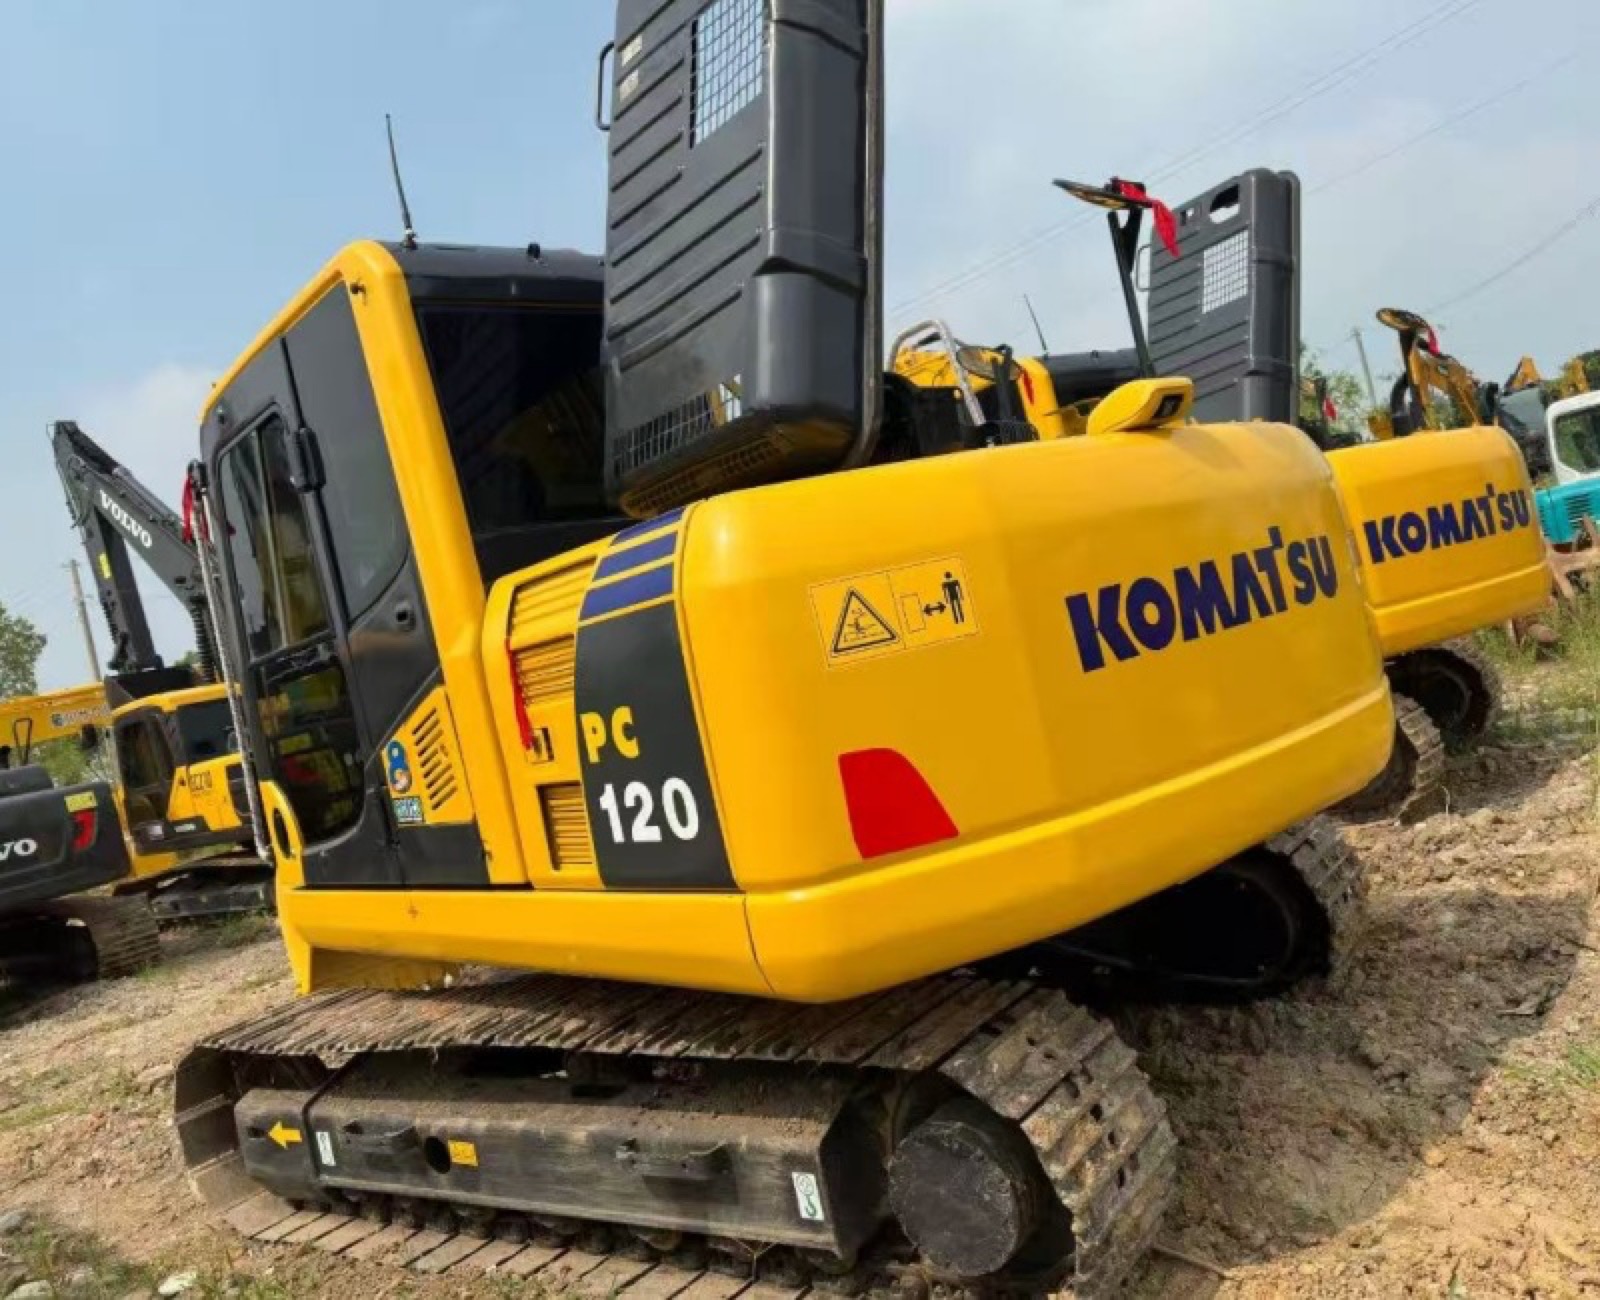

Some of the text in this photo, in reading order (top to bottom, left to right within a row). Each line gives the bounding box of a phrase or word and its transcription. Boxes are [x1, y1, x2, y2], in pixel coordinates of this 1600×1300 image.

[100, 489, 153, 548] VOLVO
[1363, 482, 1531, 565] KOMATSU
[1065, 526, 1338, 672] KOMATSU
[580, 706, 641, 764] PC
[600, 776, 699, 844] 120
